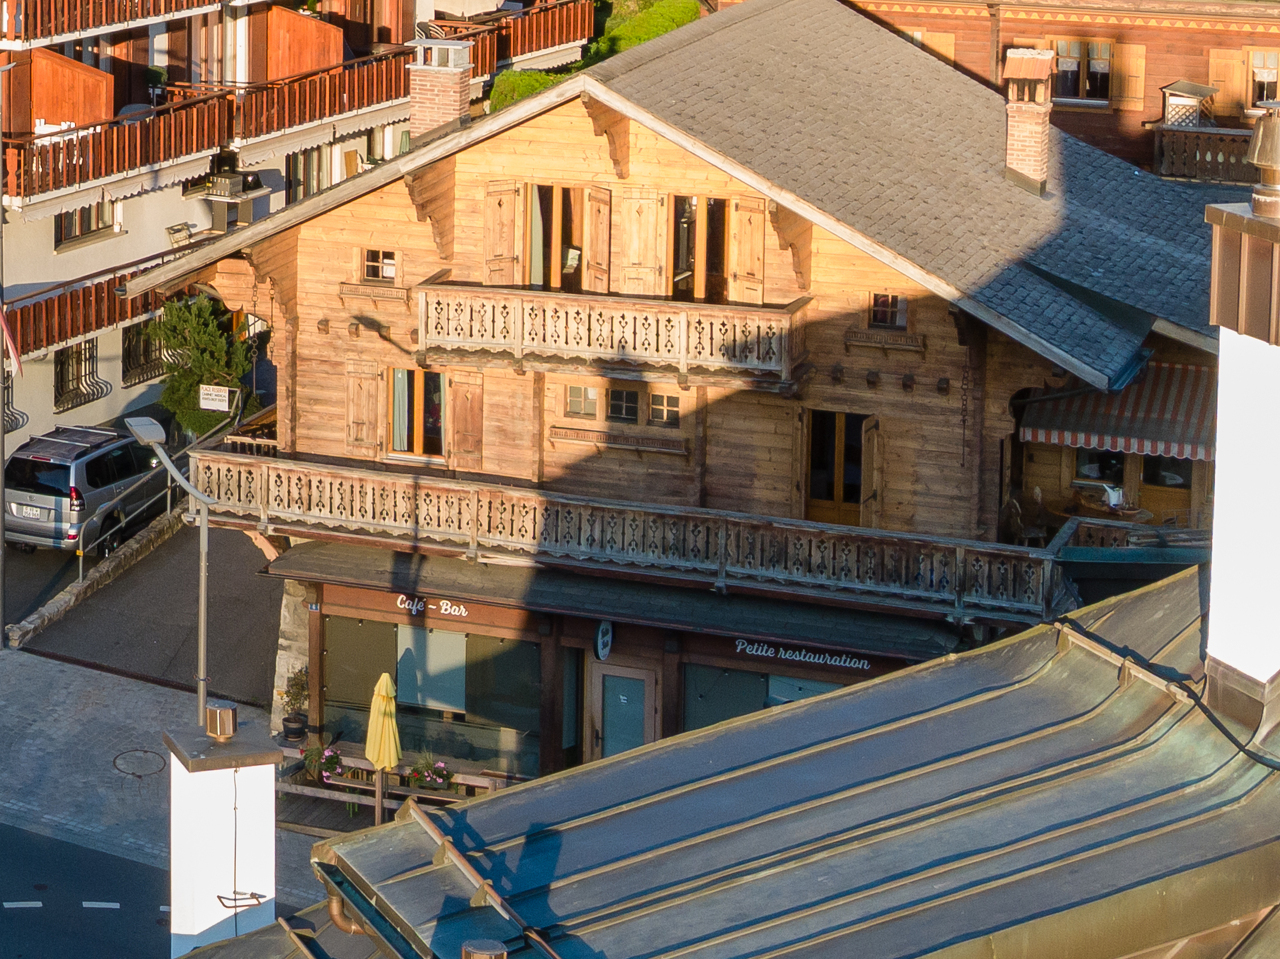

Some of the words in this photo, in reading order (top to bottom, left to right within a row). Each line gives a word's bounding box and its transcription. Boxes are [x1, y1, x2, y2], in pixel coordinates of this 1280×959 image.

[396, 594, 426, 615] Café
[439, 600, 468, 617] Bar
[735, 639, 776, 657] Petite
[777, 647, 871, 670] restauration
